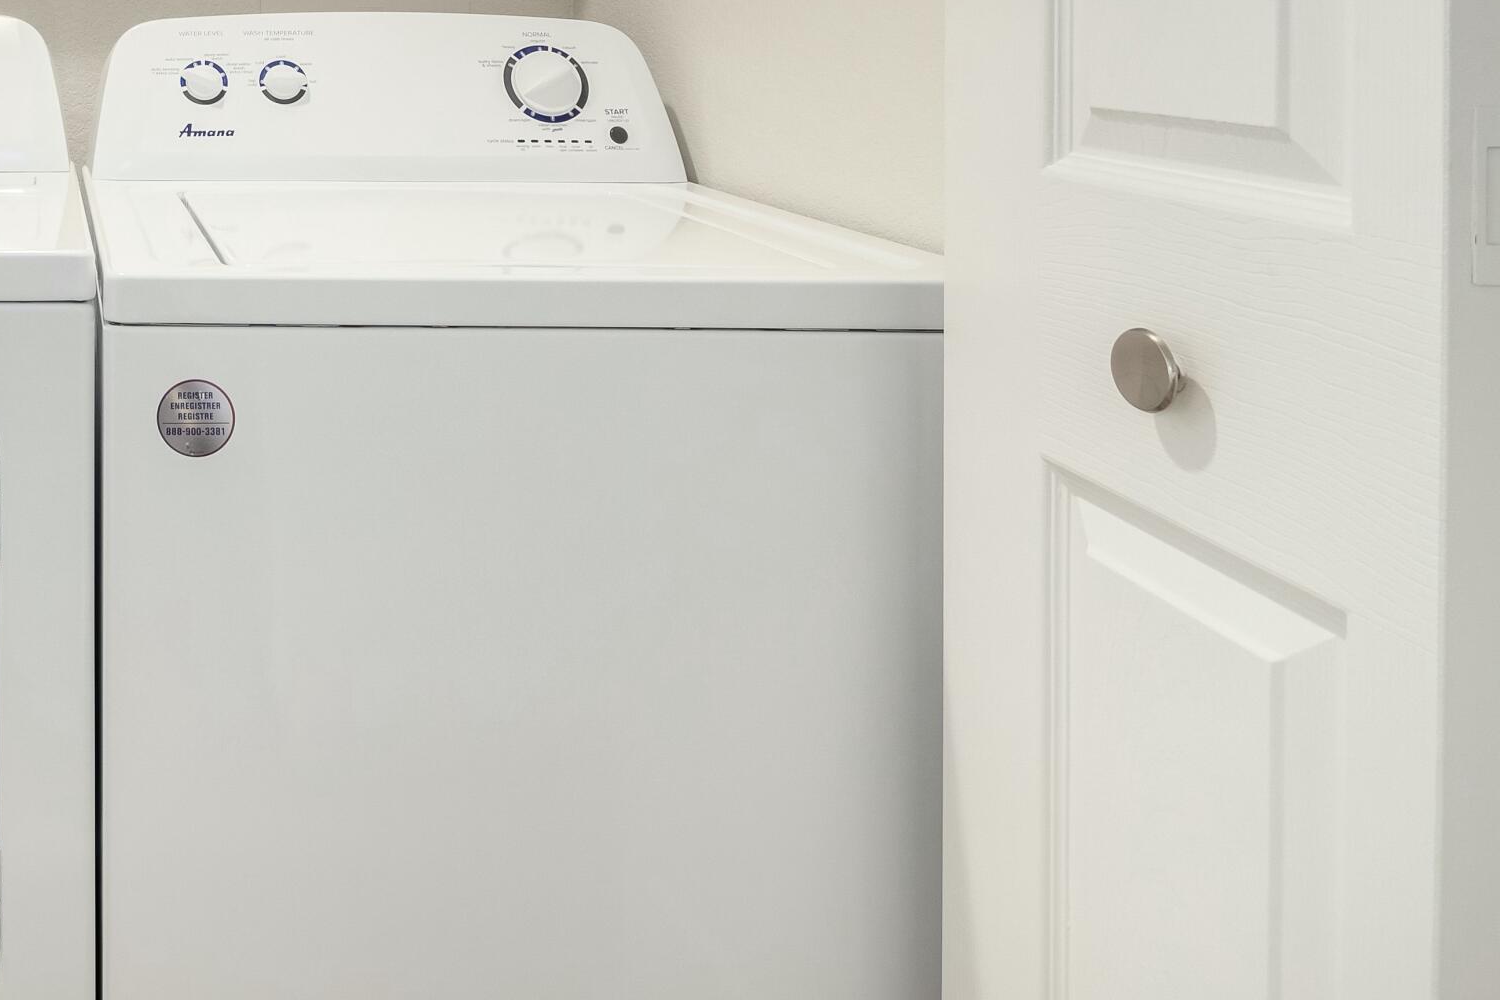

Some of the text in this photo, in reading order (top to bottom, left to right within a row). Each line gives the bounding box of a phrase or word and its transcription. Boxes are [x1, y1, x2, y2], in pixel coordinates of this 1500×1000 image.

[179, 123, 235, 138] Amana
[177, 391, 213, 400] REGISTER
[170, 402, 220, 410] ENREGISTRER
[177, 412, 214, 420] REGISTRE
[166, 427, 225, 436] 888-900-3381
